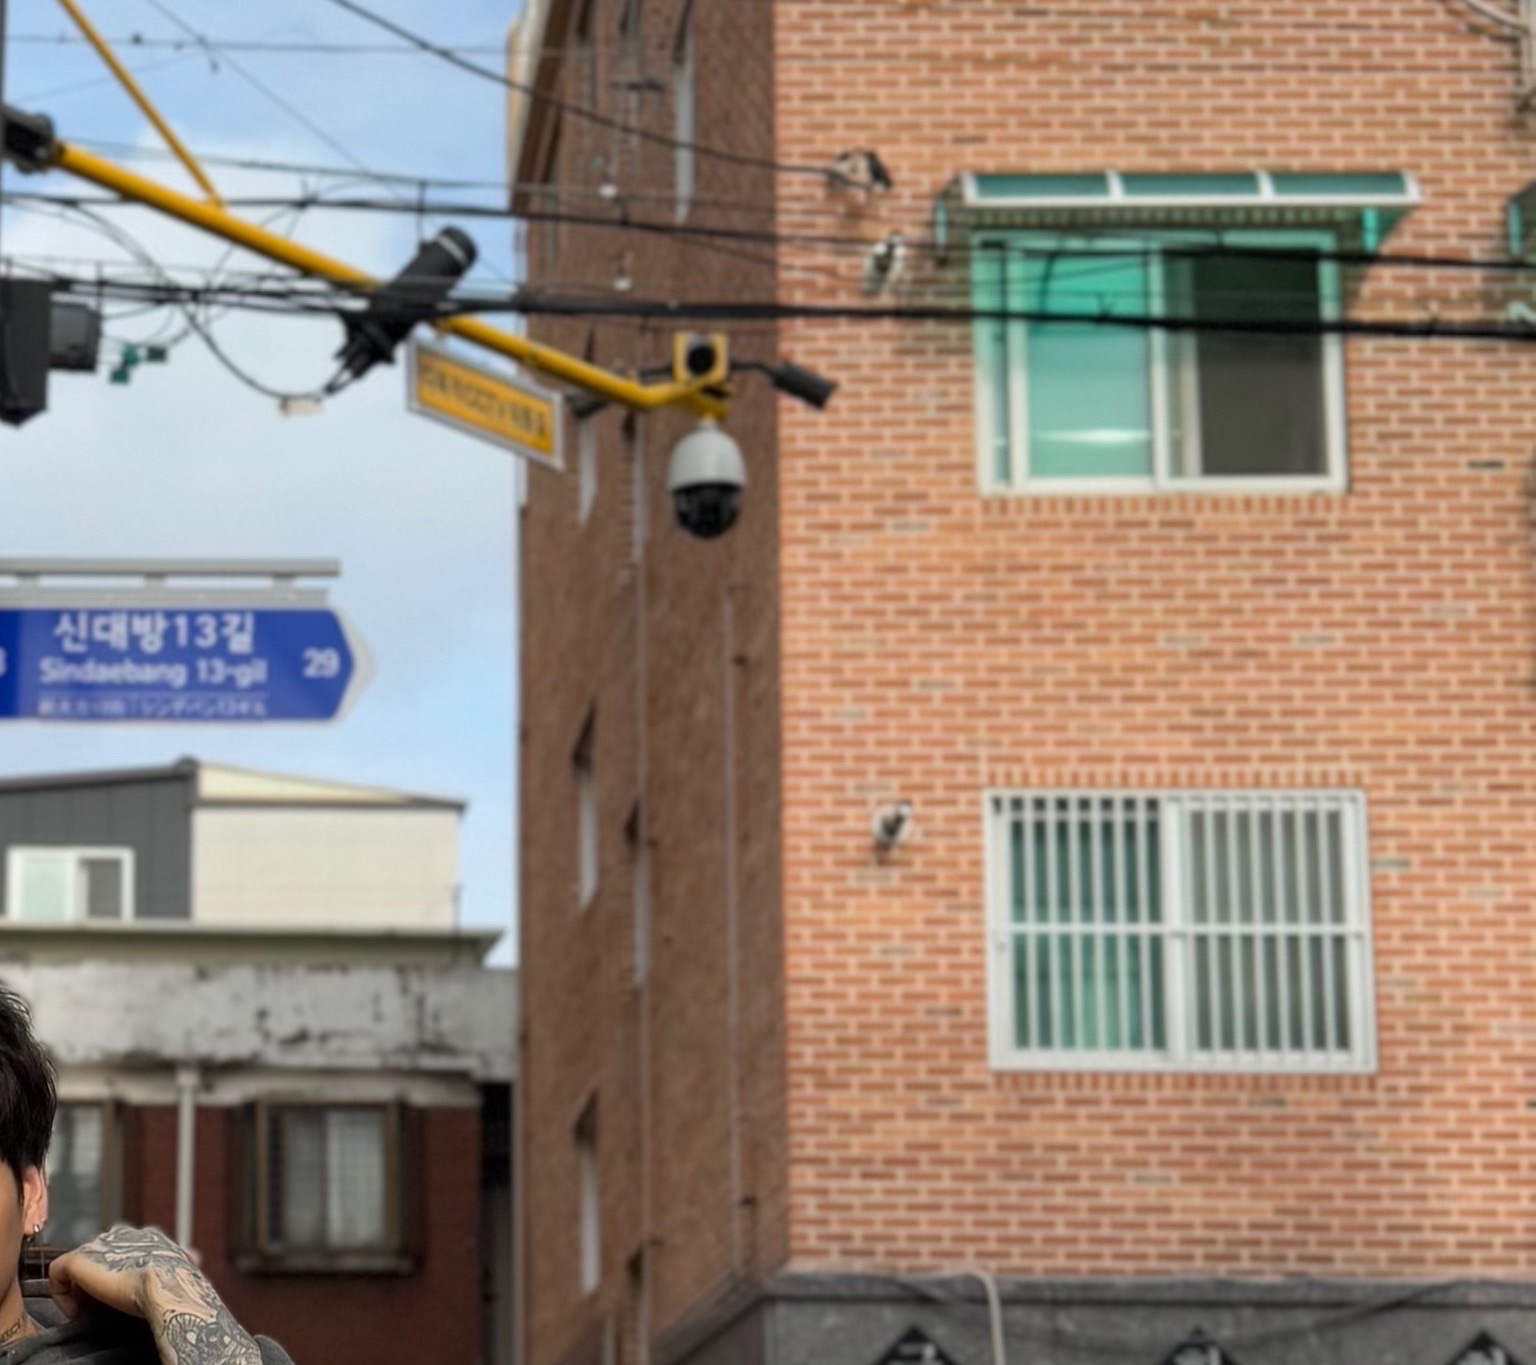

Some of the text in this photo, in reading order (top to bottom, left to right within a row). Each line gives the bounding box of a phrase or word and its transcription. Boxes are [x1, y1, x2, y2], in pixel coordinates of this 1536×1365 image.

[54, 611, 255, 654] 신대방13길
[39, 657, 267, 690] Sindaebang 13-gil
[303, 648, 341, 678] 29
